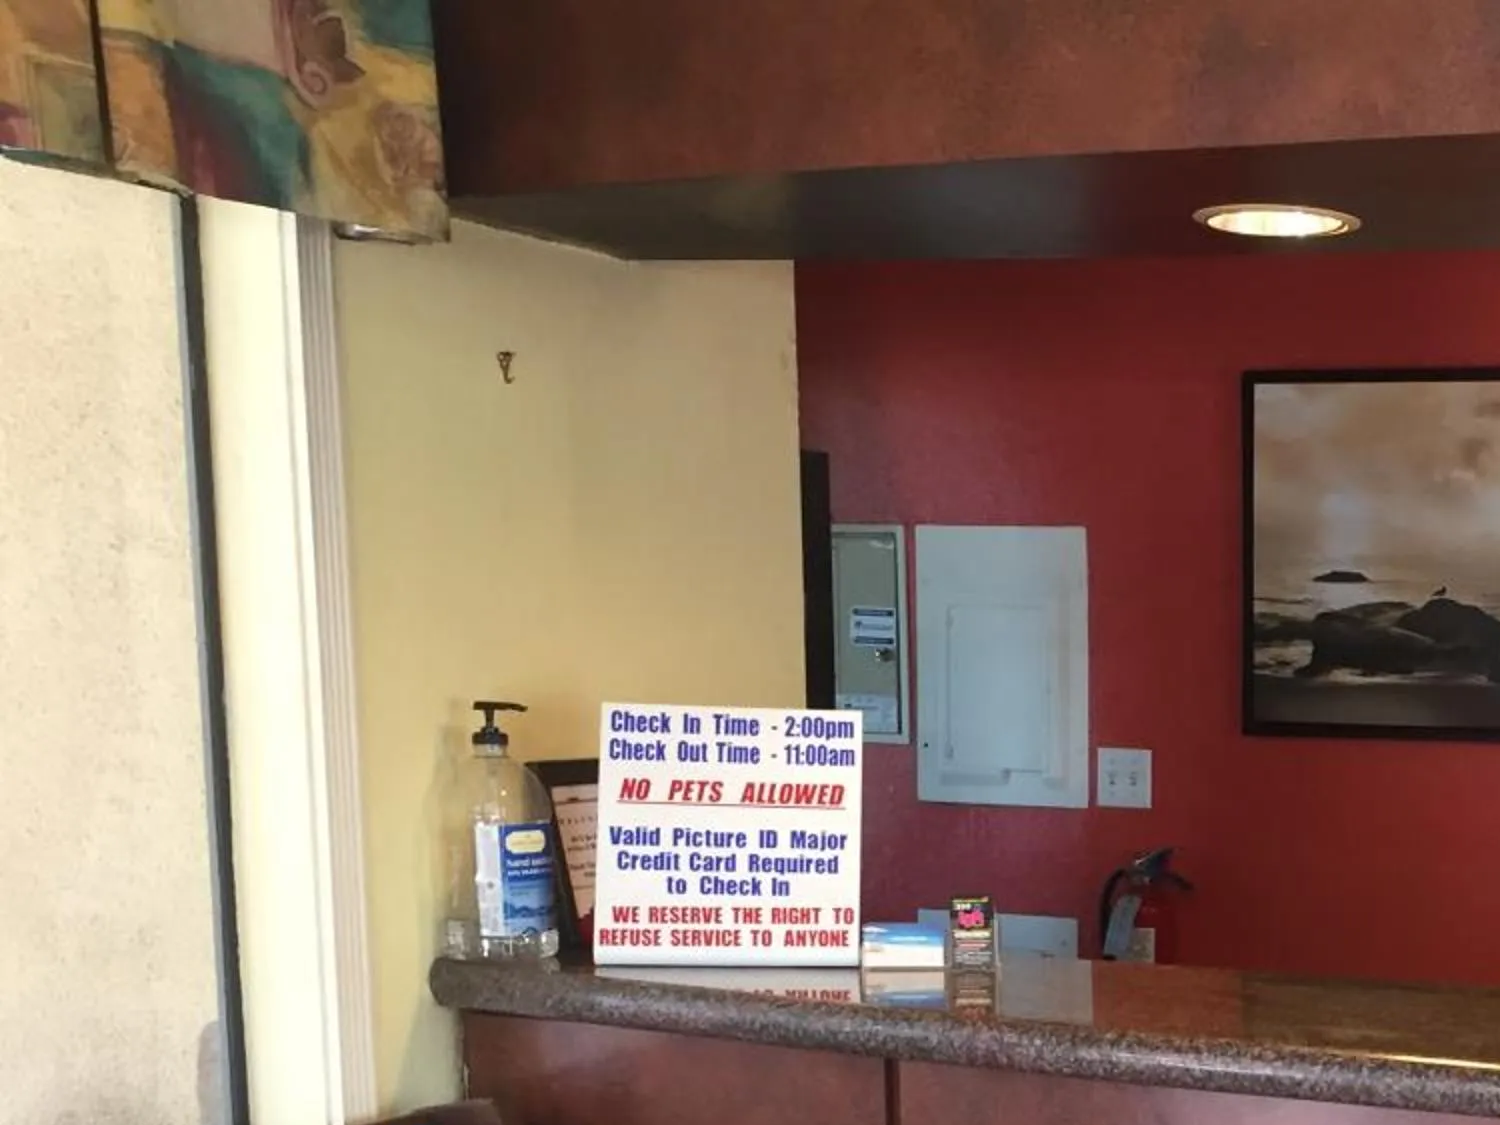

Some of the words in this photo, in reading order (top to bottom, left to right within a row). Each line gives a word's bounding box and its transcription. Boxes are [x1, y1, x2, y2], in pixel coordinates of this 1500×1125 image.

[610, 710, 672, 734] Check
[683, 713, 701, 735] In
[713, 713, 760, 737] Time
[784, 716, 856, 741] 2:00pm
[608, 738, 667, 762] Check
[677, 740, 708, 763] Out
[716, 741, 761, 765] Time
[784, 743, 856, 767] 11:00am
[619, 777, 652, 800] NO
[667, 779, 724, 803] PETS
[740, 782, 846, 806] ALLOWED
[608, 826, 661, 847] Valid
[672, 827, 748, 849] Picture
[758, 829, 778, 849] ID
[790, 830, 848, 852] Major
[616, 850, 681, 872] Credit
[688, 851, 737, 873] Card
[747, 853, 840, 876] Required
[667, 876, 687, 895] to
[699, 875, 762, 897] Check
[771, 877, 791, 896] In
[611, 905, 640, 924] WE
[648, 906, 723, 925] RESERVE
[731, 906, 763, 925] THE
[771, 907, 822, 925] RIGHT
[831, 907, 855, 925] TO
[598, 928, 662, 947] REFUSE
[670, 929, 742, 948] SERVICE
[751, 929, 773, 948] TO
[783, 929, 850, 948] ANYONE
